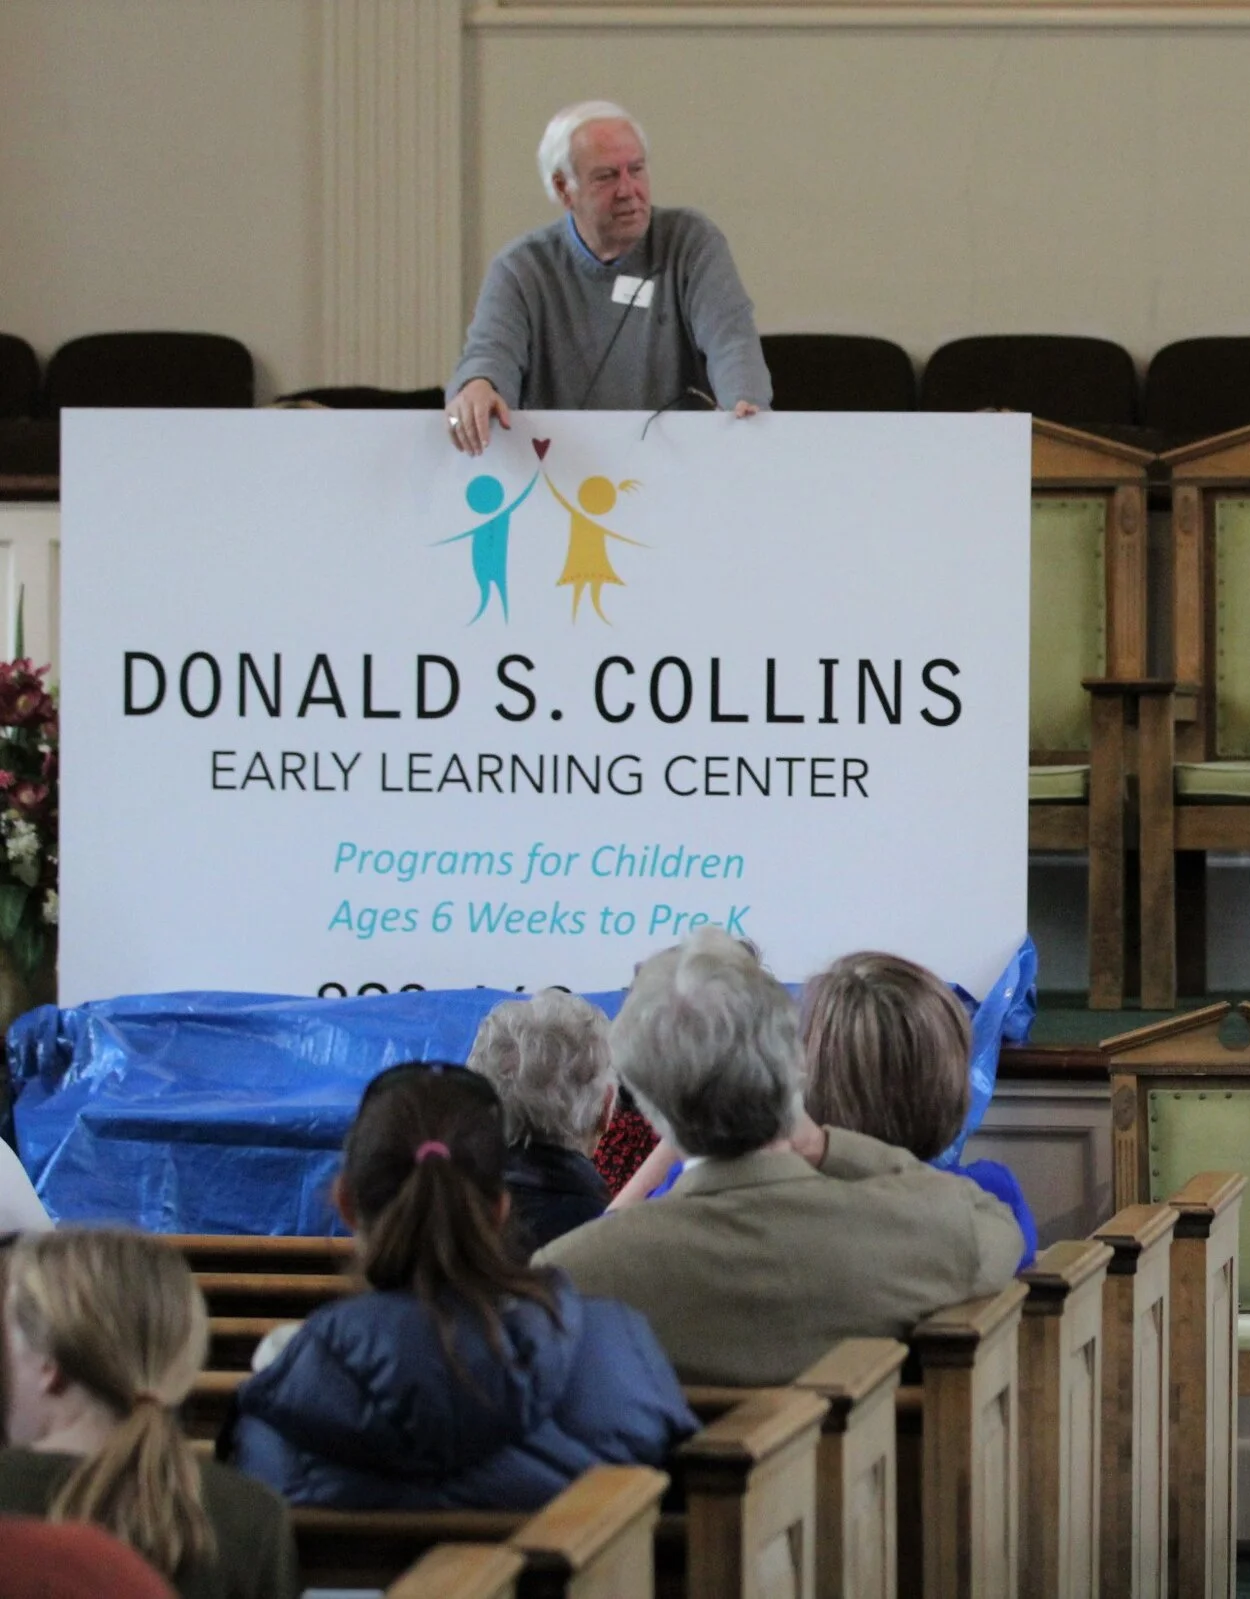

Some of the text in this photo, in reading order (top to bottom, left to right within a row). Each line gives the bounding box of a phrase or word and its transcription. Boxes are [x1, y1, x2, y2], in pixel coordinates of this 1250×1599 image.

[123, 651, 962, 727] DONALD S. COLLINS
[211, 750, 869, 798] EARLY LEARNING CENTER
[334, 841, 744, 884] Programs for Children
[327, 899, 751, 940] Ages 6 Weeks to Pre-K
